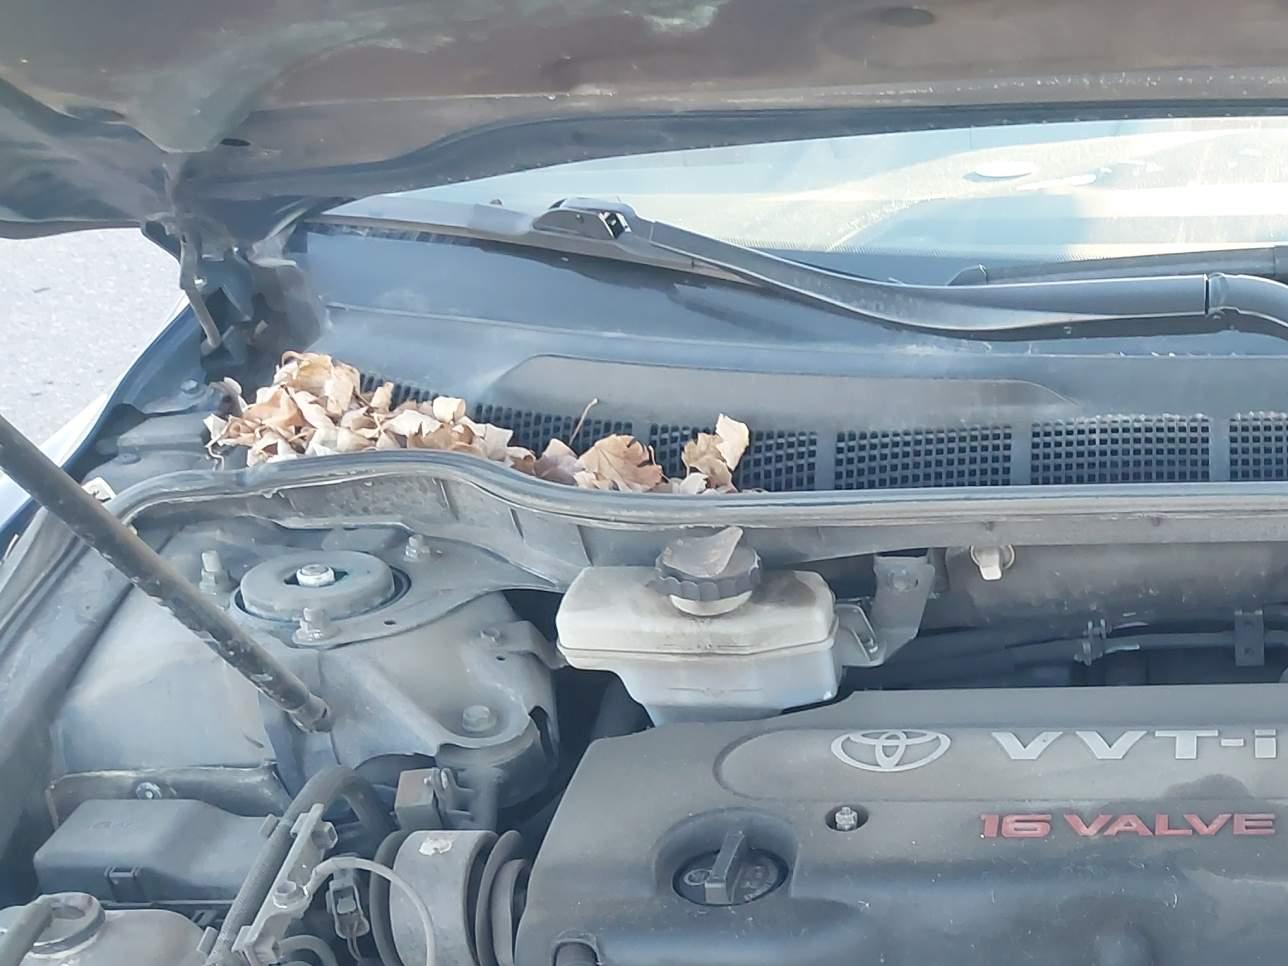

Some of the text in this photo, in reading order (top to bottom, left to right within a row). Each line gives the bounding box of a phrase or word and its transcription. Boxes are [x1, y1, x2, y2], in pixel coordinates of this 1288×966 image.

[991, 729, 1278, 760] VVT-i
[980, 814, 1277, 838] 16 VALVE
